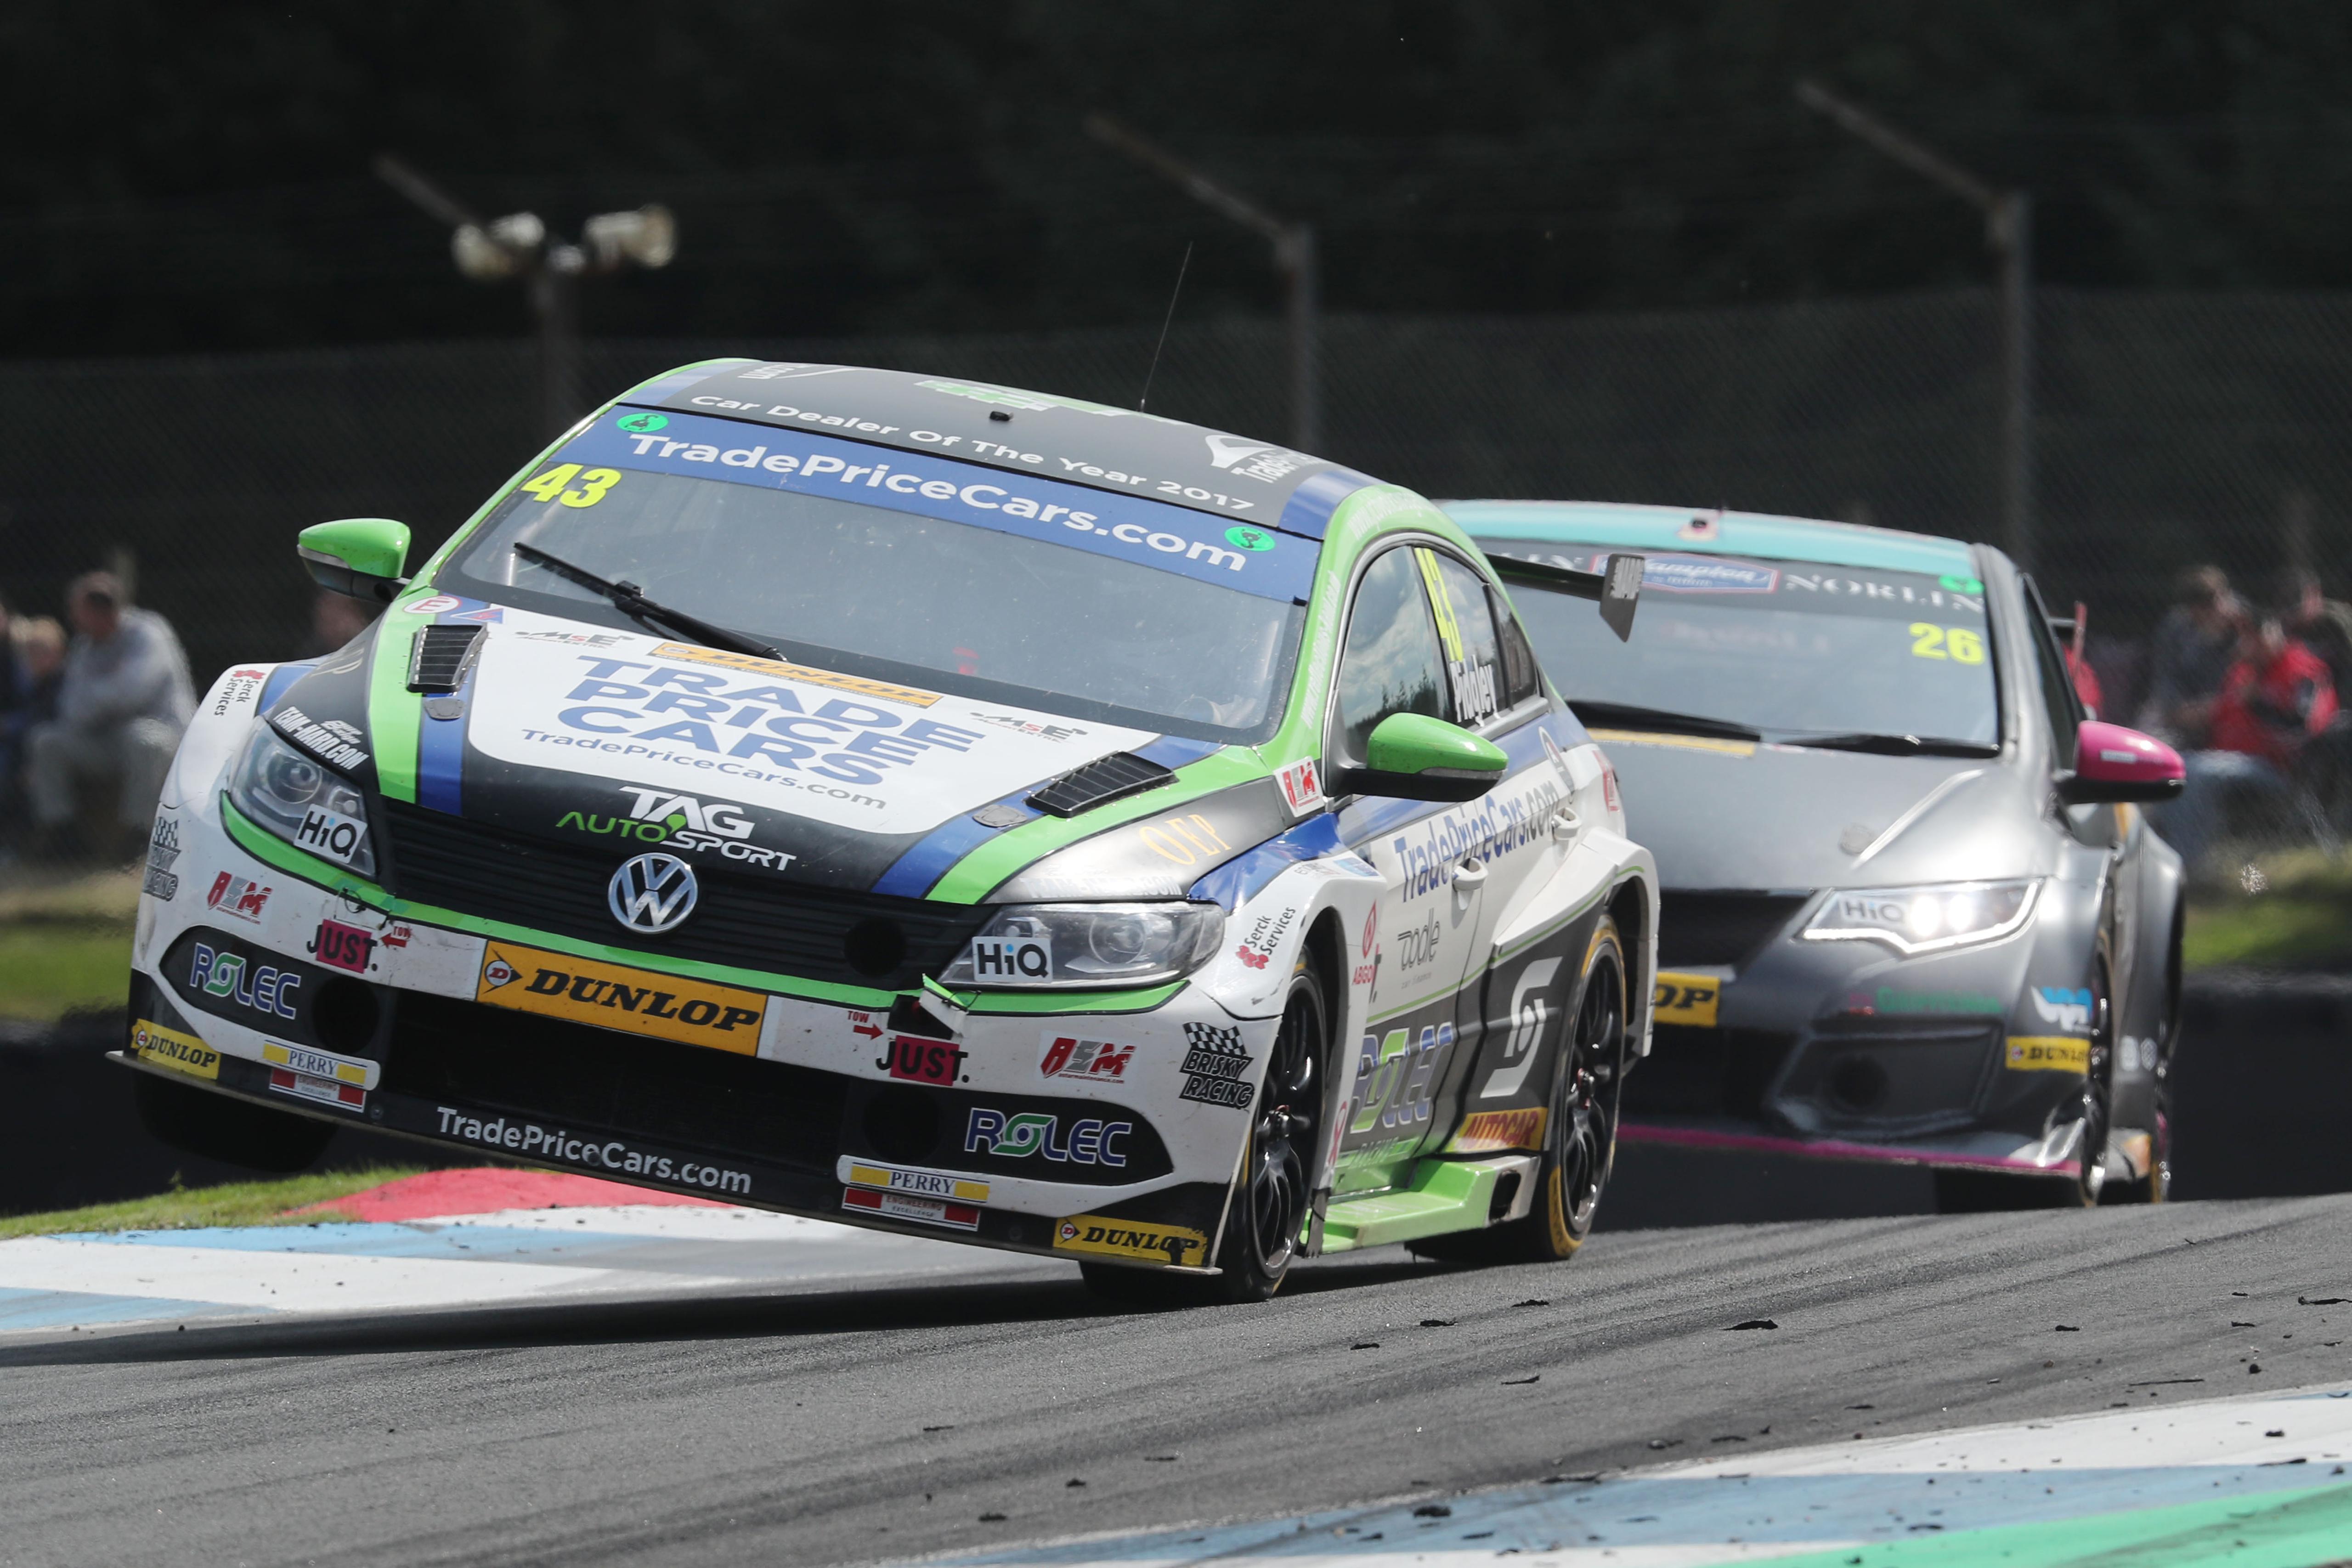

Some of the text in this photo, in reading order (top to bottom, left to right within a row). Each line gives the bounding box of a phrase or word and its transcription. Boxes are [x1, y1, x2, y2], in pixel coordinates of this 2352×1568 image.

[691, 396, 1255, 510] Car Dealer Of The Year 2017
[520, 463, 622, 508] 43
[628, 434, 1247, 572] TradePriceCars.com
[1908, 622, 1984, 665] 26
[214, 677, 243, 716] Services
[236, 678, 259, 703] Serck
[701, 654, 936, 700] DUNLOP
[1449, 654, 1501, 728] Pidgley
[565, 679, 933, 766] PRICE
[577, 655, 987, 753] TRADE
[272, 706, 370, 770] TEAM-HARD.COM
[557, 706, 884, 786] CARS
[522, 729, 887, 809] TradePriceCars.com
[297, 810, 358, 857] HiQ
[619, 786, 756, 839] TAG
[1244, 914, 1272, 948] Serck
[1260, 906, 1296, 956] Services
[189, 942, 301, 1020] ROLEC
[977, 943, 1049, 979] HiQ
[525, 968, 761, 1031] DUNLOP
[848, 1010, 869, 1023] TOW
[147, 1034, 217, 1068] DUNLOP
[289, 1050, 339, 1076] PERRY
[1183, 1050, 1249, 1080] BRISKY
[2028, 1046, 2088, 1064] DUNLO
[1183, 1076, 1254, 1107] RACING
[437, 1106, 752, 1194] TradePriceCars.com
[964, 1107, 1133, 1167] ROLEC
[1465, 1111, 1540, 1149] AUTOCAR
[886, 1195, 943, 1211] ENGINEERING
[889, 1172, 956, 1194] PERRY
